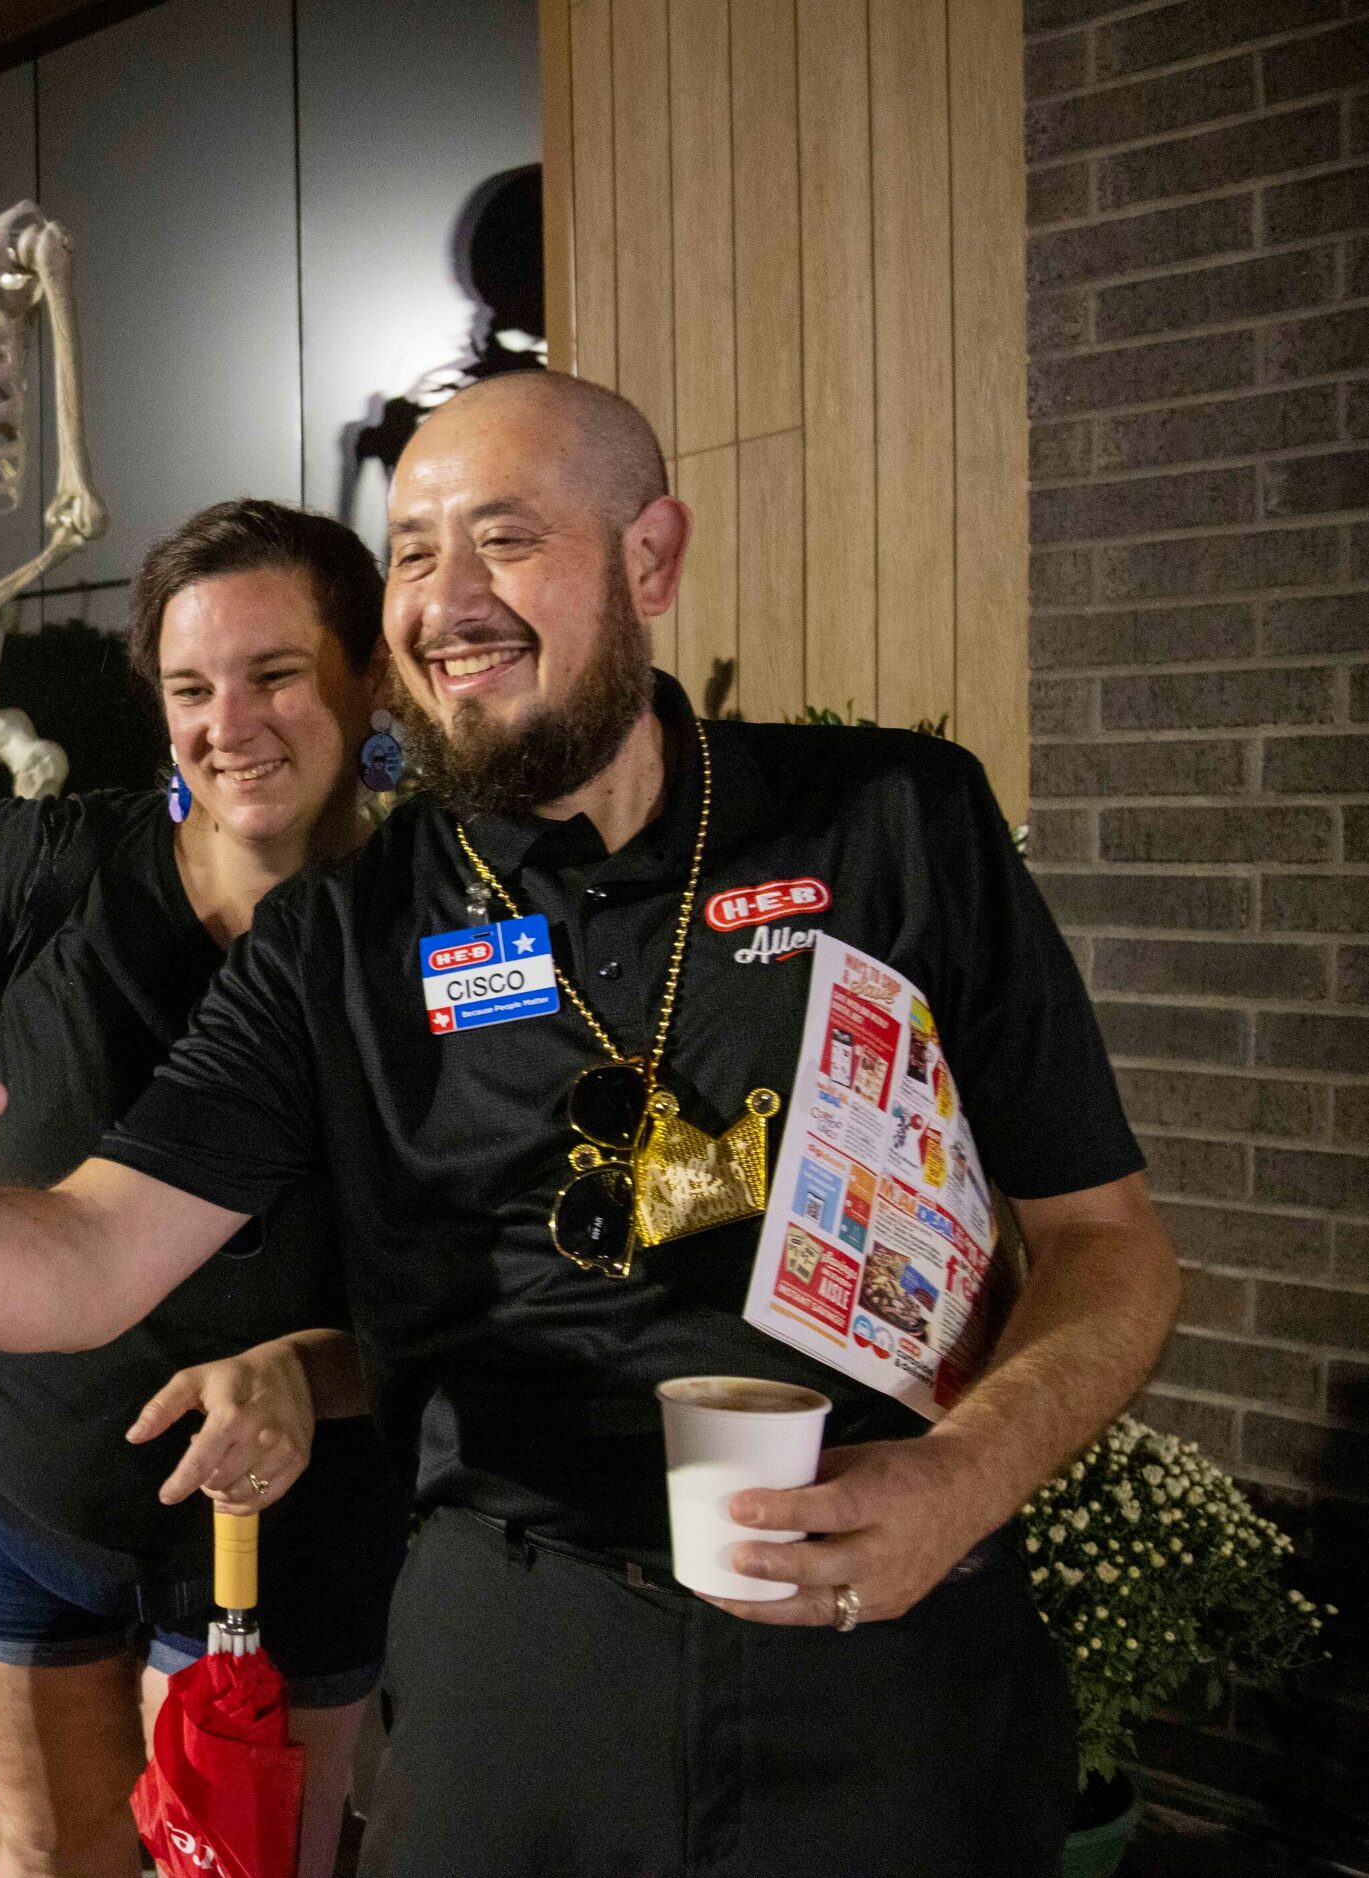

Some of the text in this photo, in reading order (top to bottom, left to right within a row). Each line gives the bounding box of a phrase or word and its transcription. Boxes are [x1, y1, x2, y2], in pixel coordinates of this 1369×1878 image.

[720, 885, 819, 921] H-E-B
[435, 945, 487, 966] H-E-B
[446, 969, 525, 1002] CISCO
[461, 997, 550, 1018] Because People Matter
[596, 1216, 604, 1227] UV
[916, 1203, 953, 1239] DEAL
